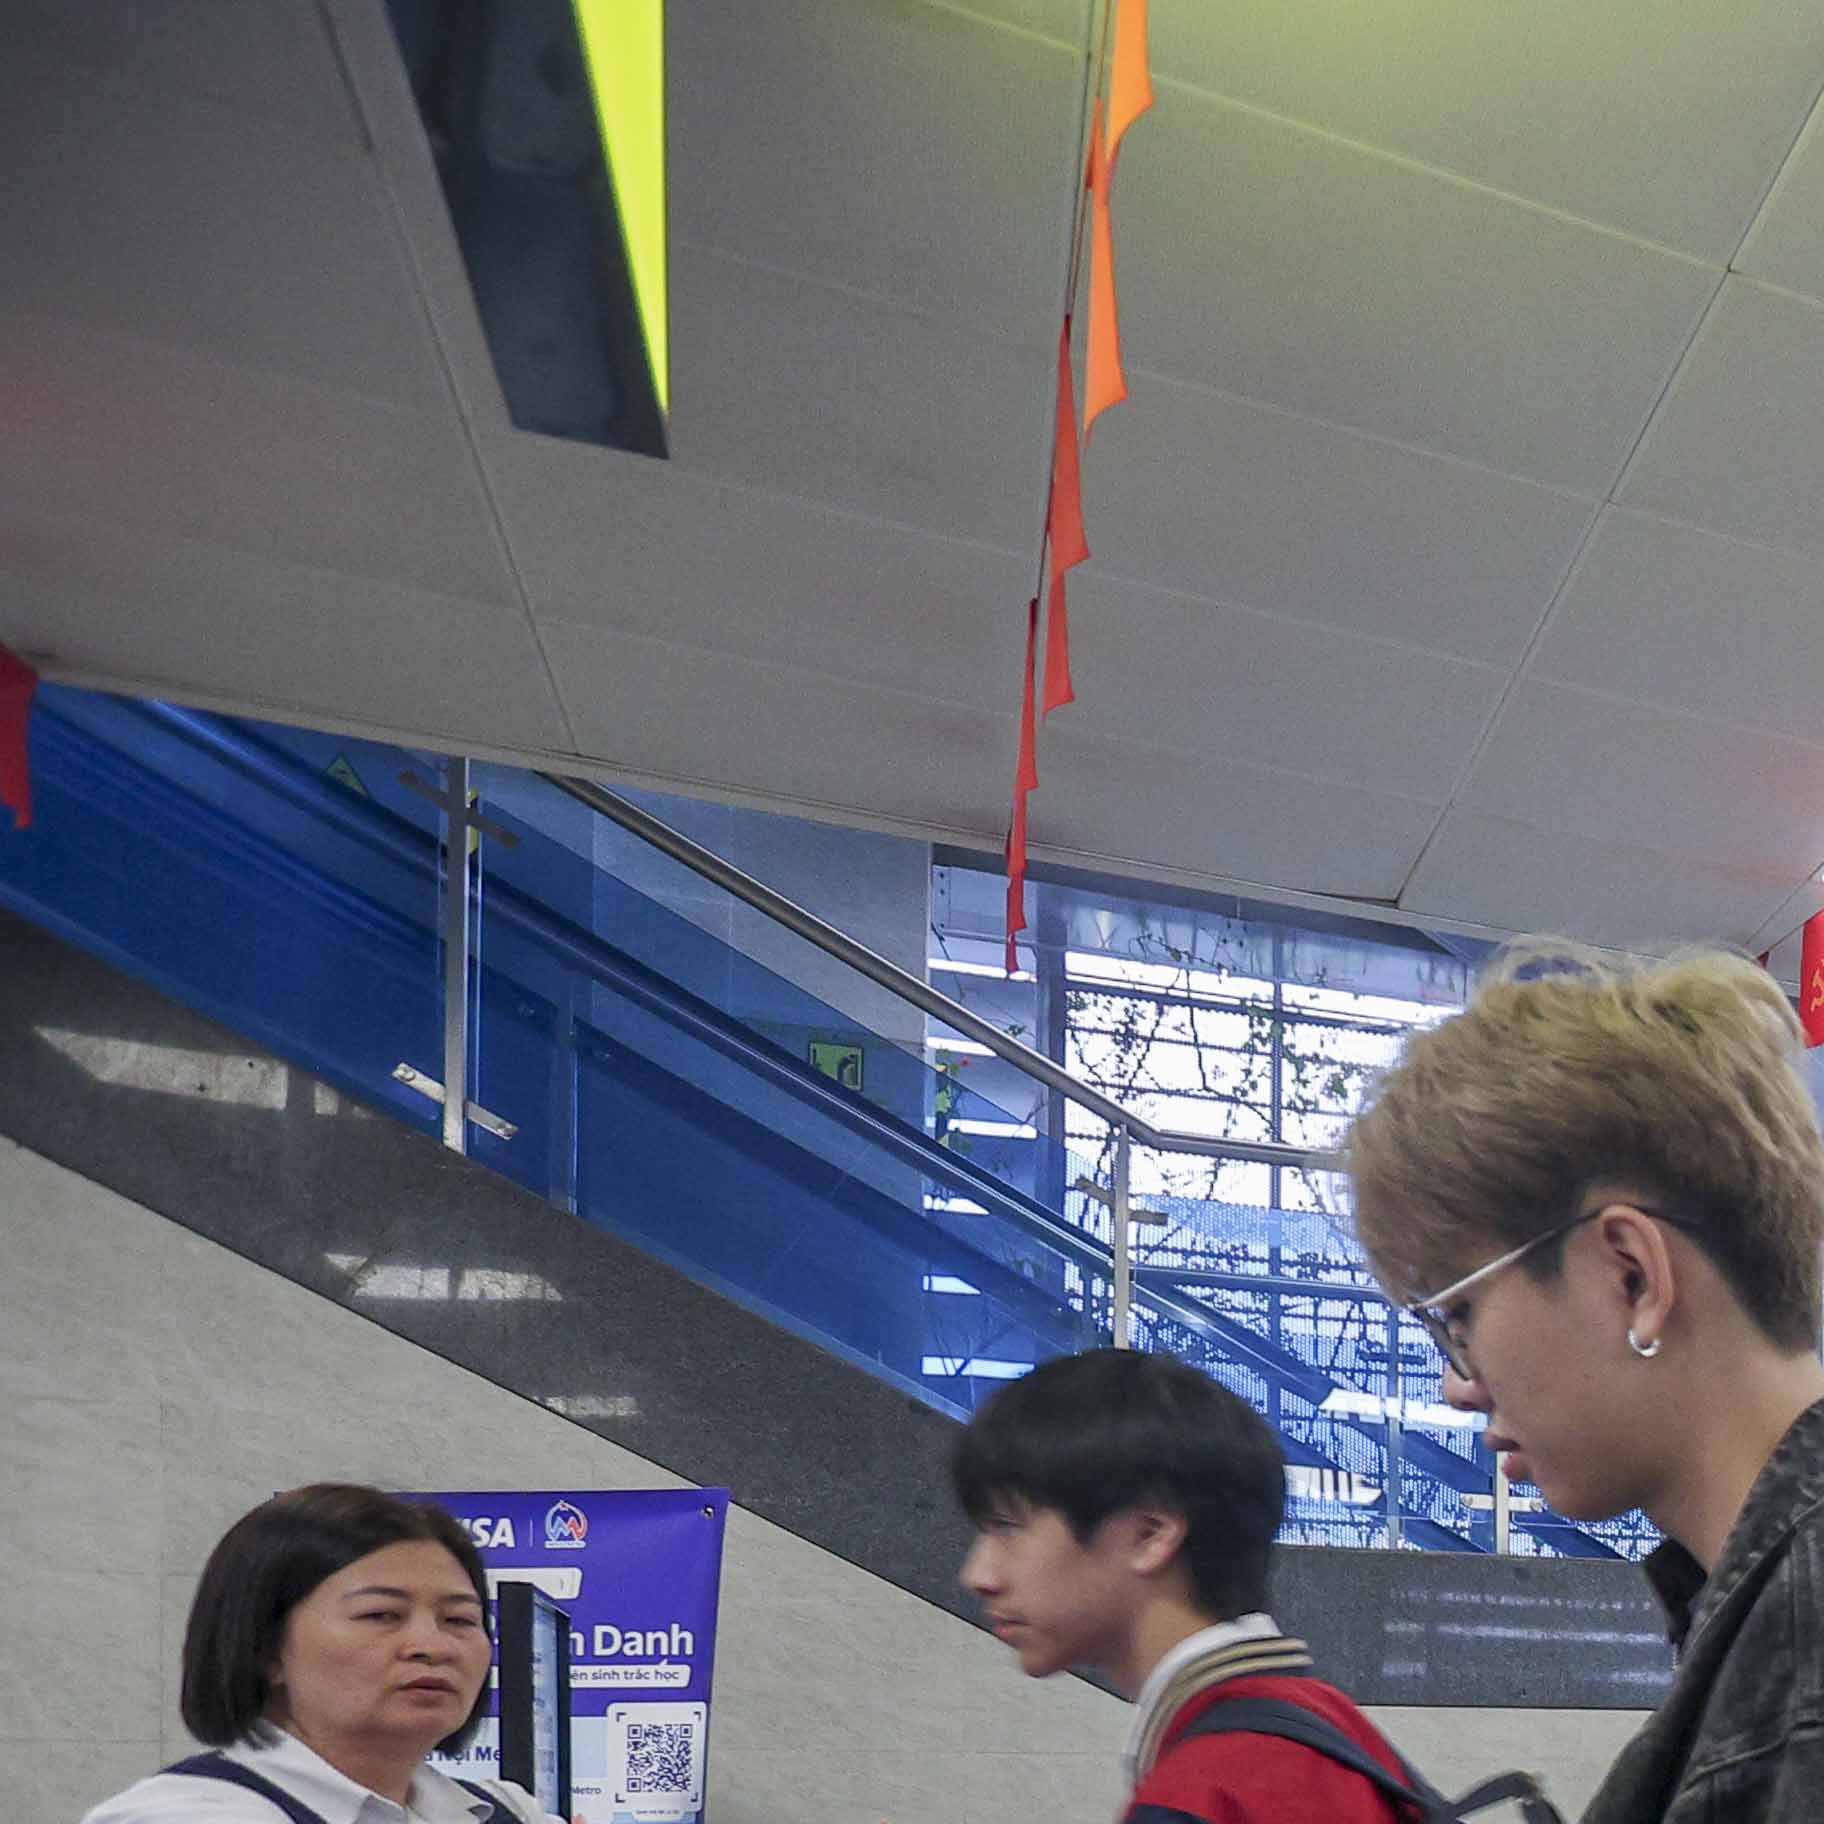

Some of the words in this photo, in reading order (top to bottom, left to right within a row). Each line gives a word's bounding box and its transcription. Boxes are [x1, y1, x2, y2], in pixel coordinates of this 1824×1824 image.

[593, 1622, 694, 1656] Danh
[592, 1668, 621, 1681] sinh
[655, 1668, 679, 1683] học
